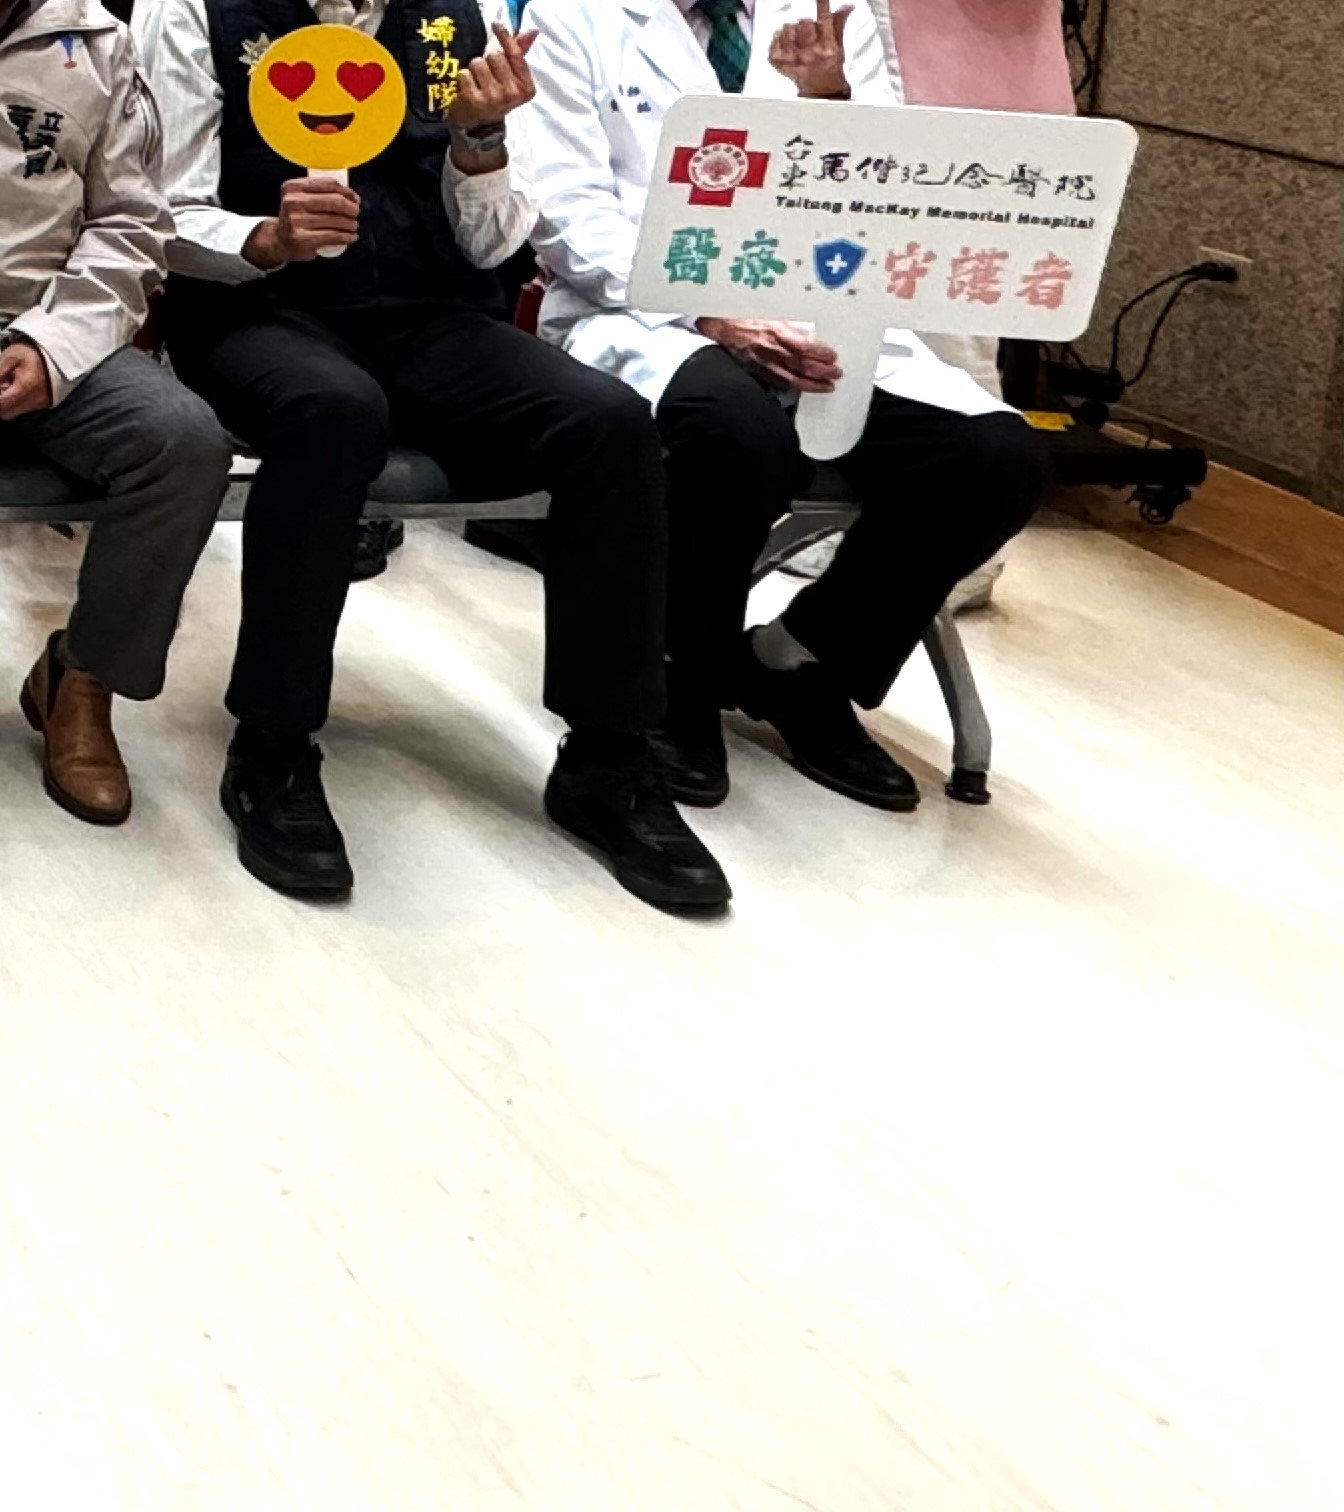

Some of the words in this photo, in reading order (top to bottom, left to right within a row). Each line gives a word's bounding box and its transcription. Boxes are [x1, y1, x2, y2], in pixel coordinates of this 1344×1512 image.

[416, 15, 460, 122] 婦幼隊
[776, 196, 844, 216] Taitung
[850, 200, 921, 220] MacKay
[927, 206, 1011, 225] Memorial
[1018, 211, 1096, 230] Hospital
[663, 226, 788, 289] 醫療
[884, 241, 1074, 310] 守護者
